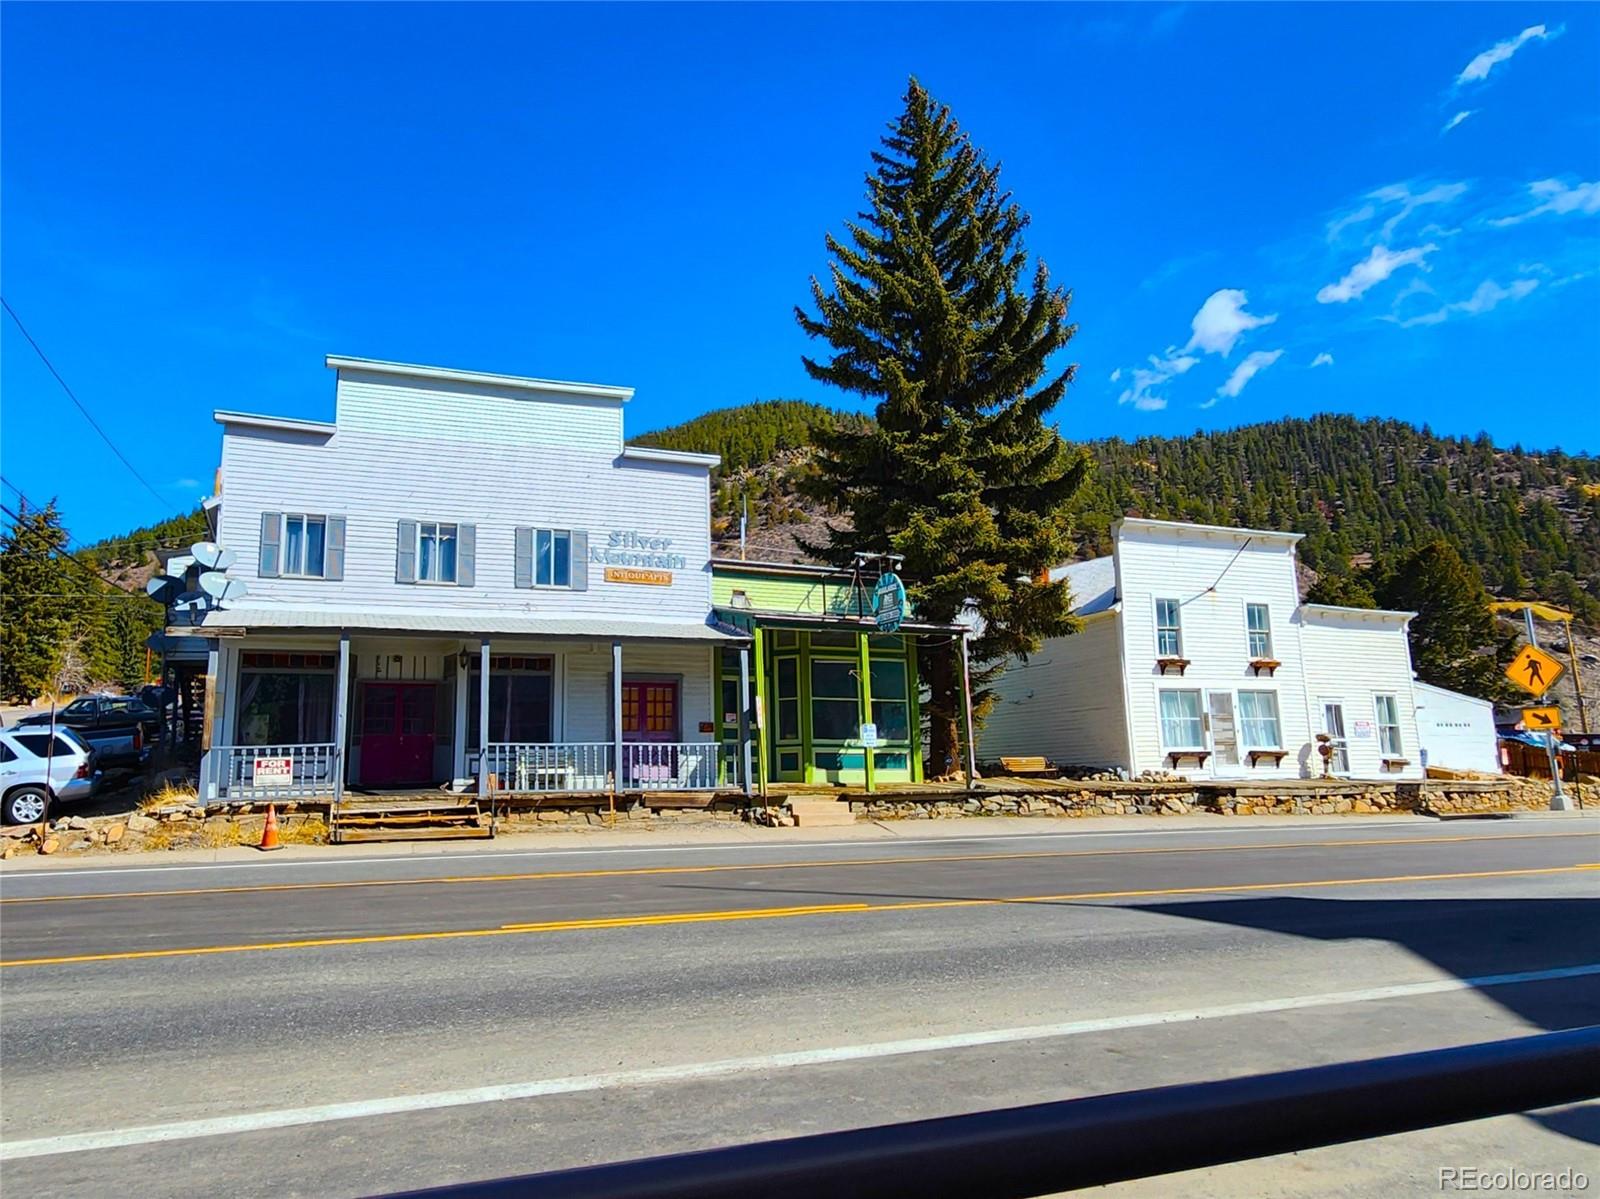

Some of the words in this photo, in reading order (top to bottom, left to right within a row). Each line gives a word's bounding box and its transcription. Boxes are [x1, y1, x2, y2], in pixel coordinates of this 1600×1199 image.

[608, 530, 673, 550] Silver
[590, 546, 686, 569] Mountain
[257, 767, 290, 775] RENT
[261, 760, 286, 768] FOR
